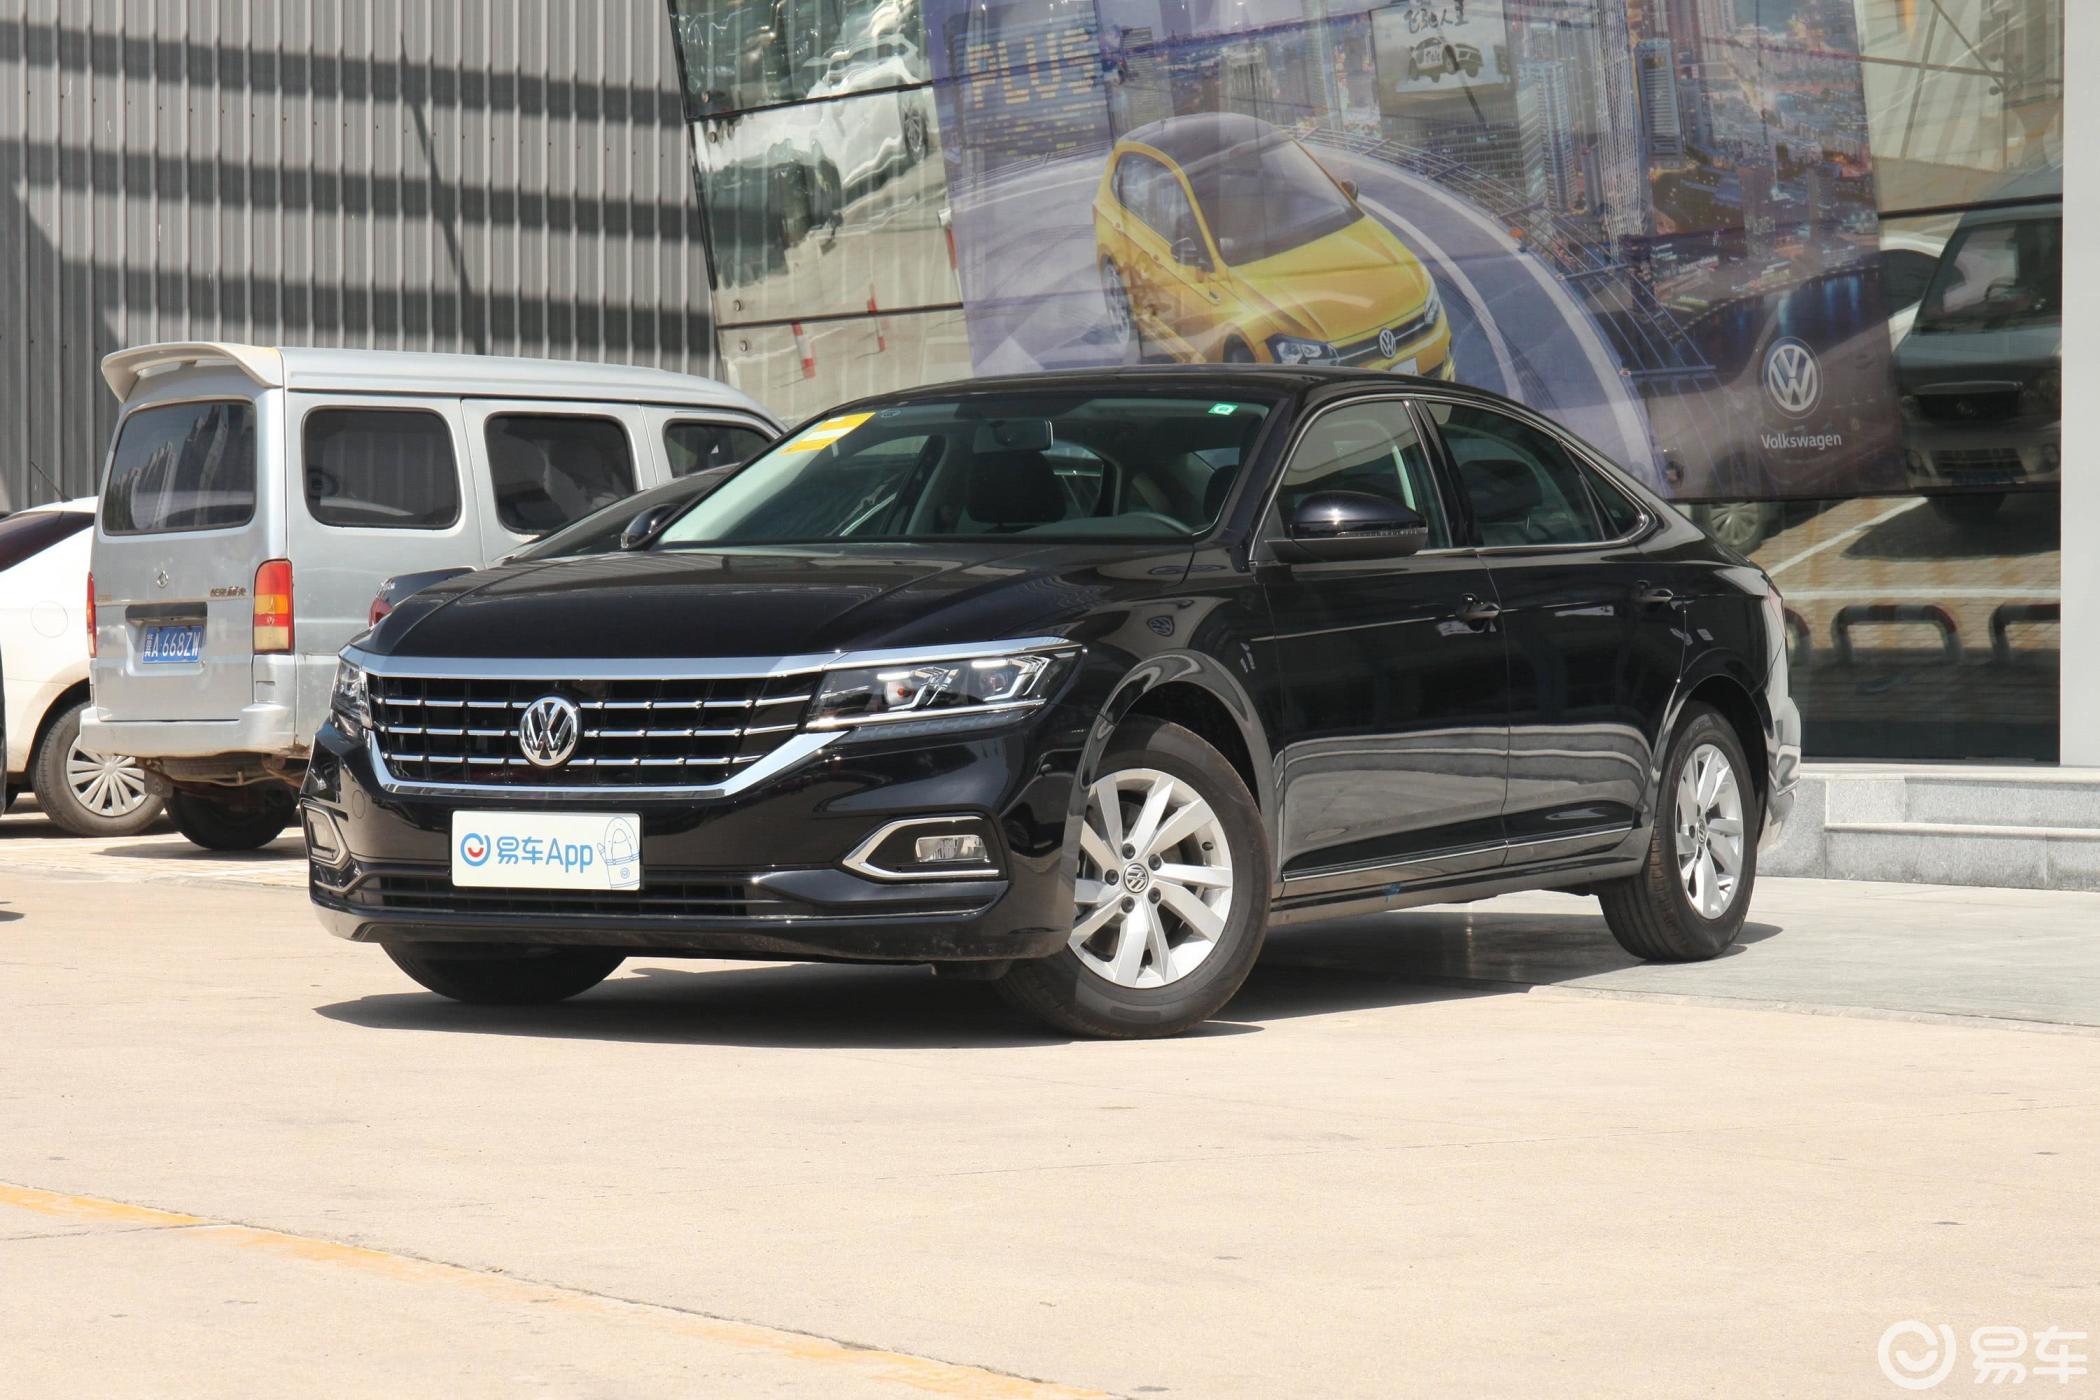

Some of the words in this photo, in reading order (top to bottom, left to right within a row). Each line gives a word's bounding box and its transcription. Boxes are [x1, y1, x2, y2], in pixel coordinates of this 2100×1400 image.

[967, 27, 1095, 109] PLUS
[1761, 433, 1842, 450] Volkswagen
[496, 836, 593, 874] 易车App
